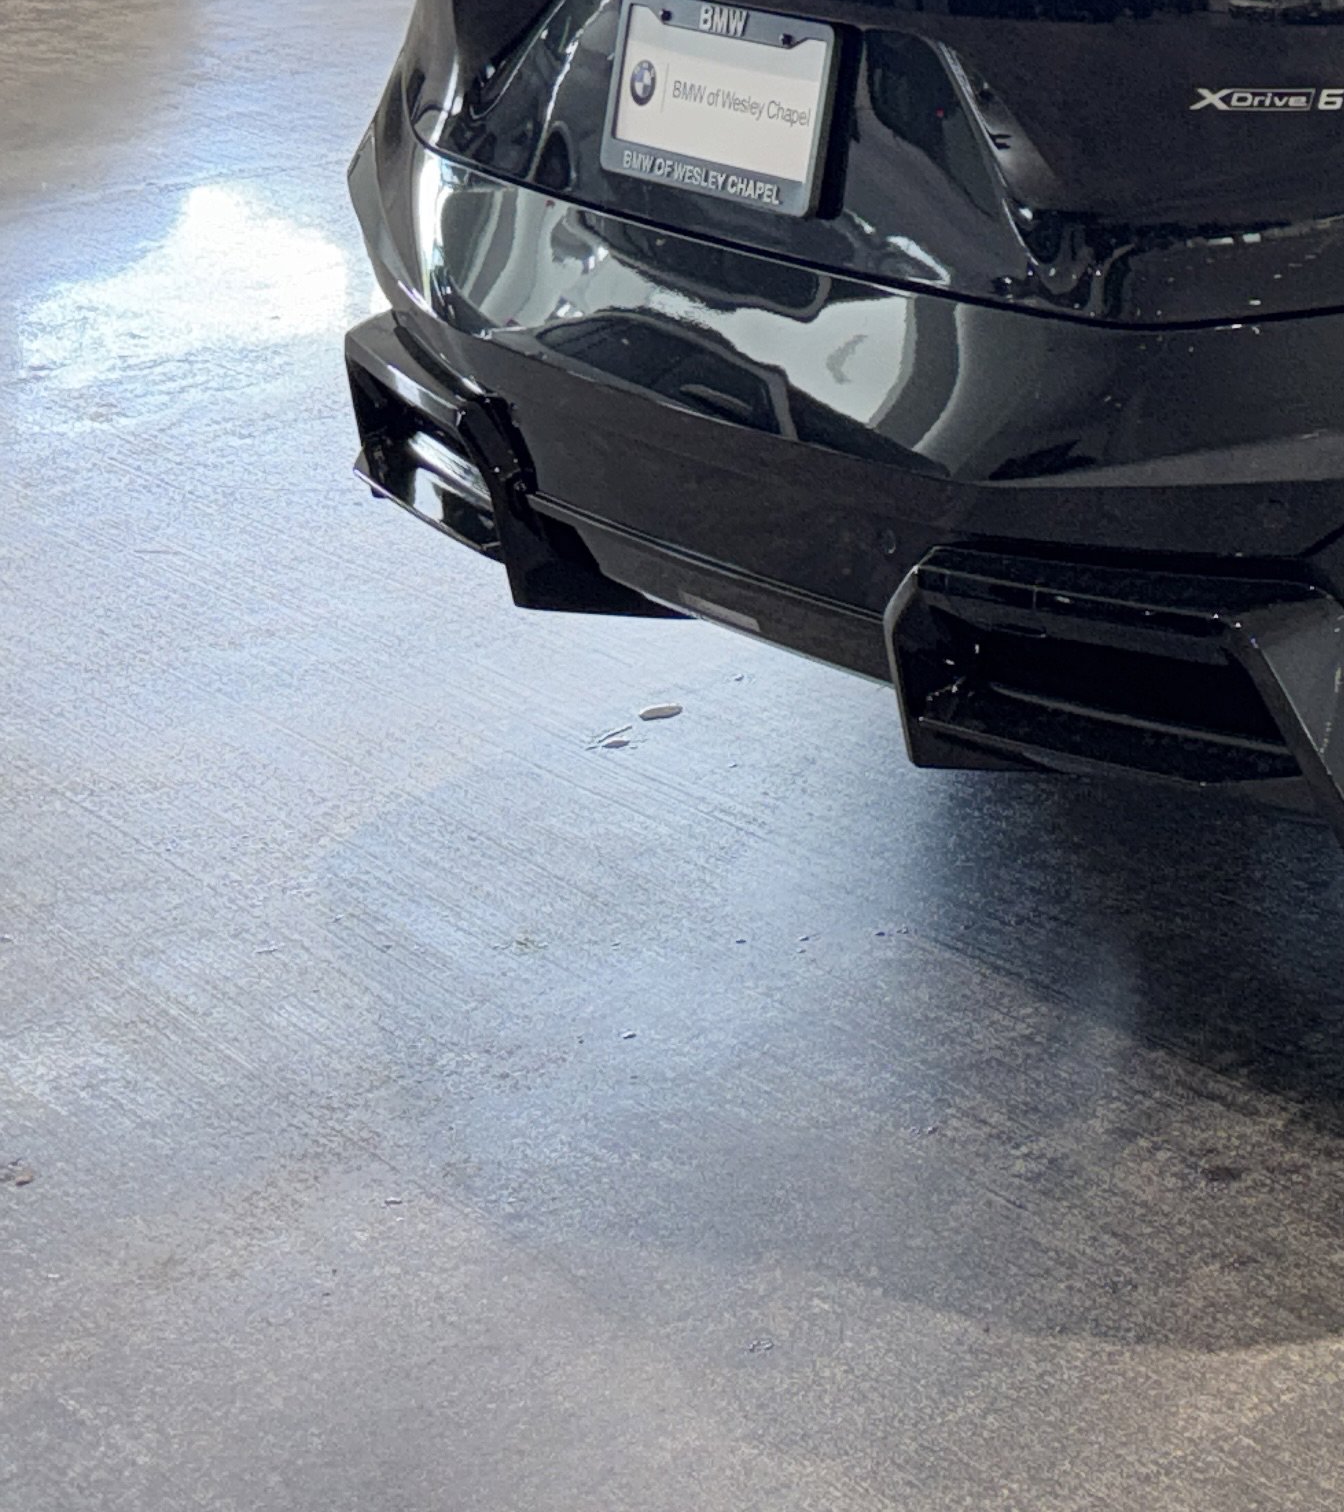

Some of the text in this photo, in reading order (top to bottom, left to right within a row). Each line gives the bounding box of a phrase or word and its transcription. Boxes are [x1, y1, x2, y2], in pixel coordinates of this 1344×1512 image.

[697, 5, 749, 37] BMW
[672, 80, 812, 128] BMW of Wesley Chapel
[623, 150, 781, 206] BMW OF WESLEY CHAPEL
